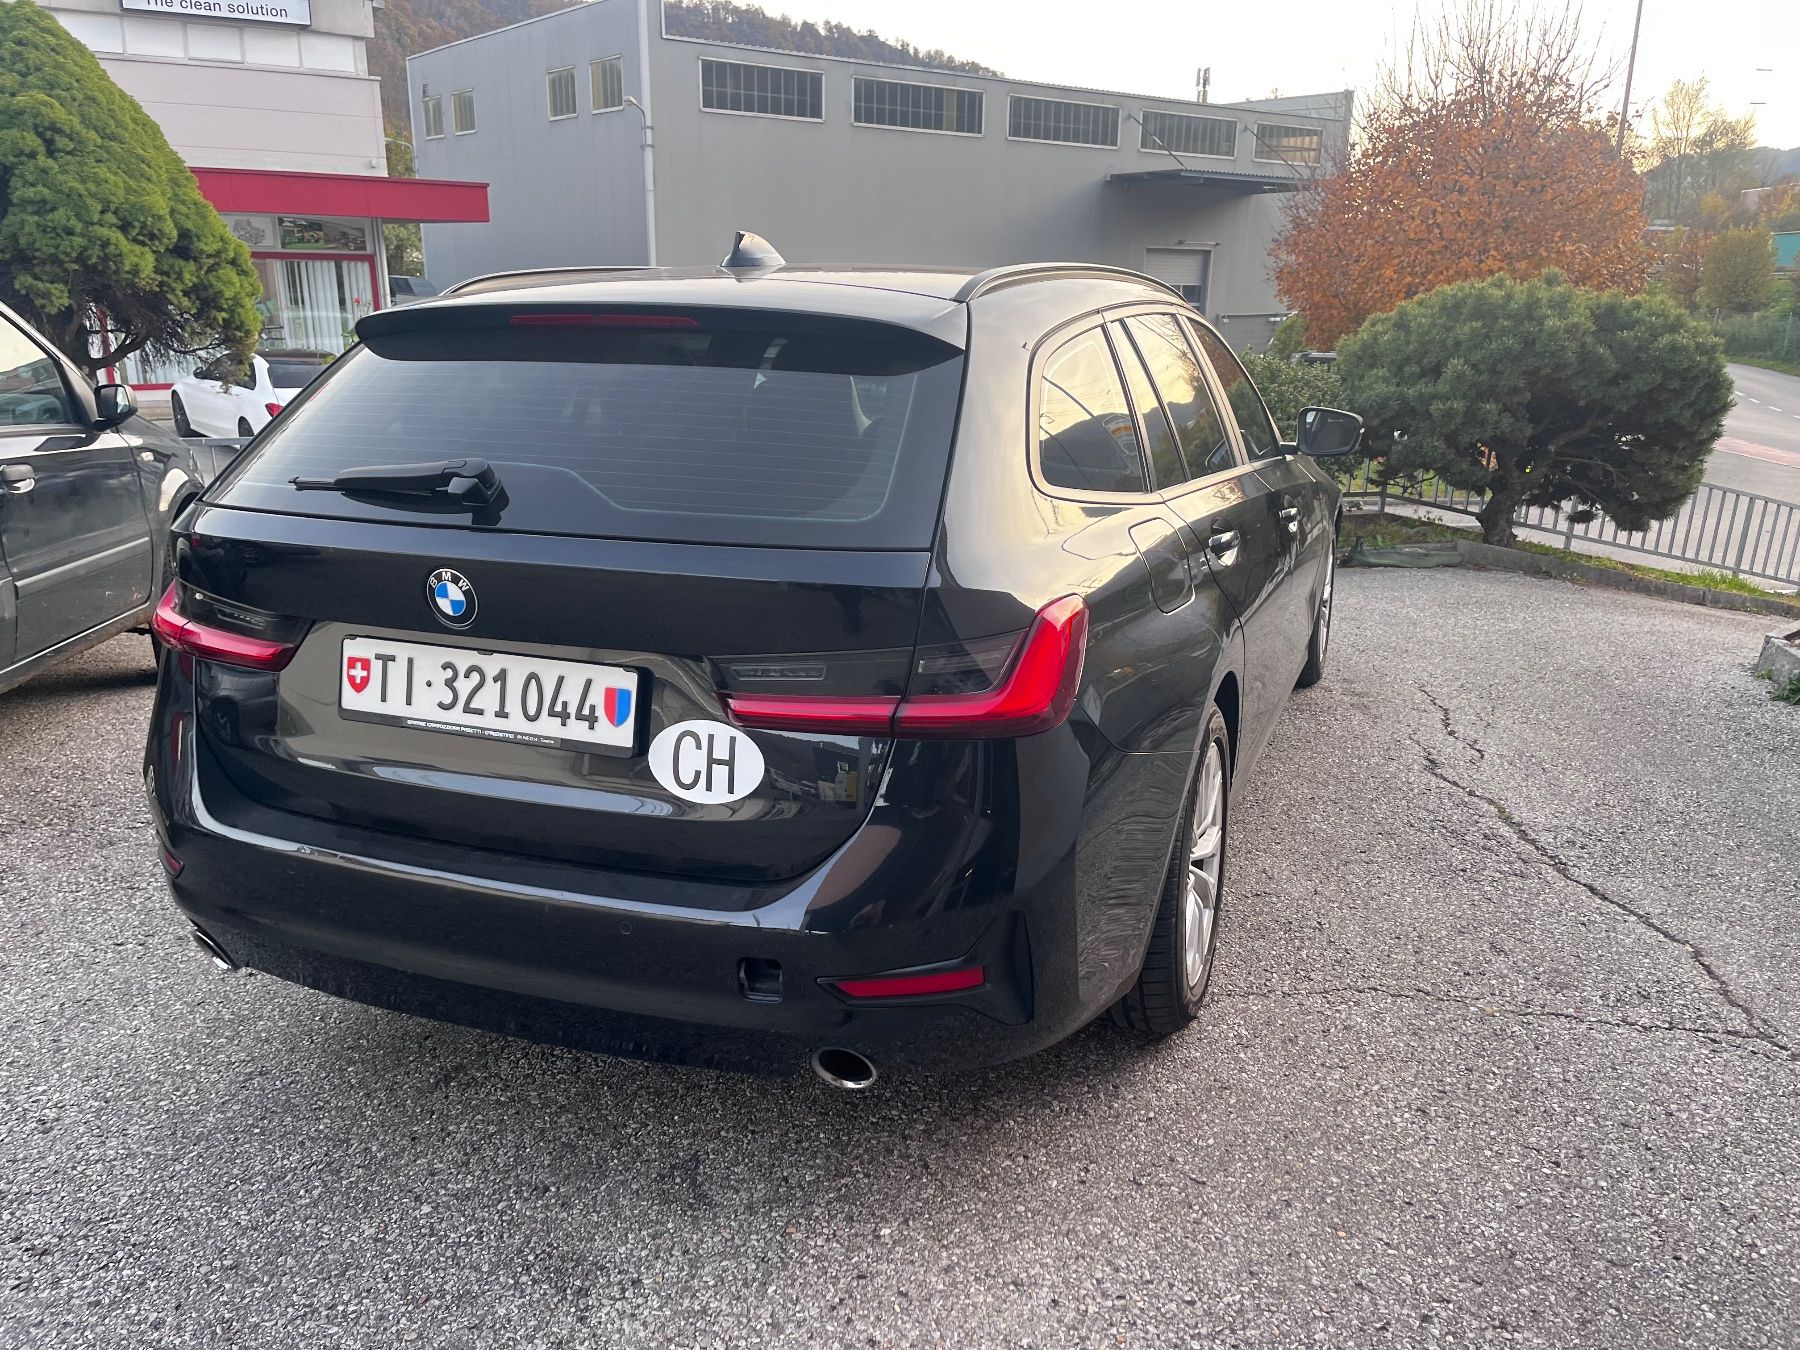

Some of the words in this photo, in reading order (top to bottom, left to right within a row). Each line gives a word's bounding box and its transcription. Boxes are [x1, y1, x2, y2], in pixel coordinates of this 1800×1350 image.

[179, 0, 222, 12] clean
[227, 2, 288, 18] solution
[429, 571, 470, 592] BMW
[672, 729, 737, 795] CH
